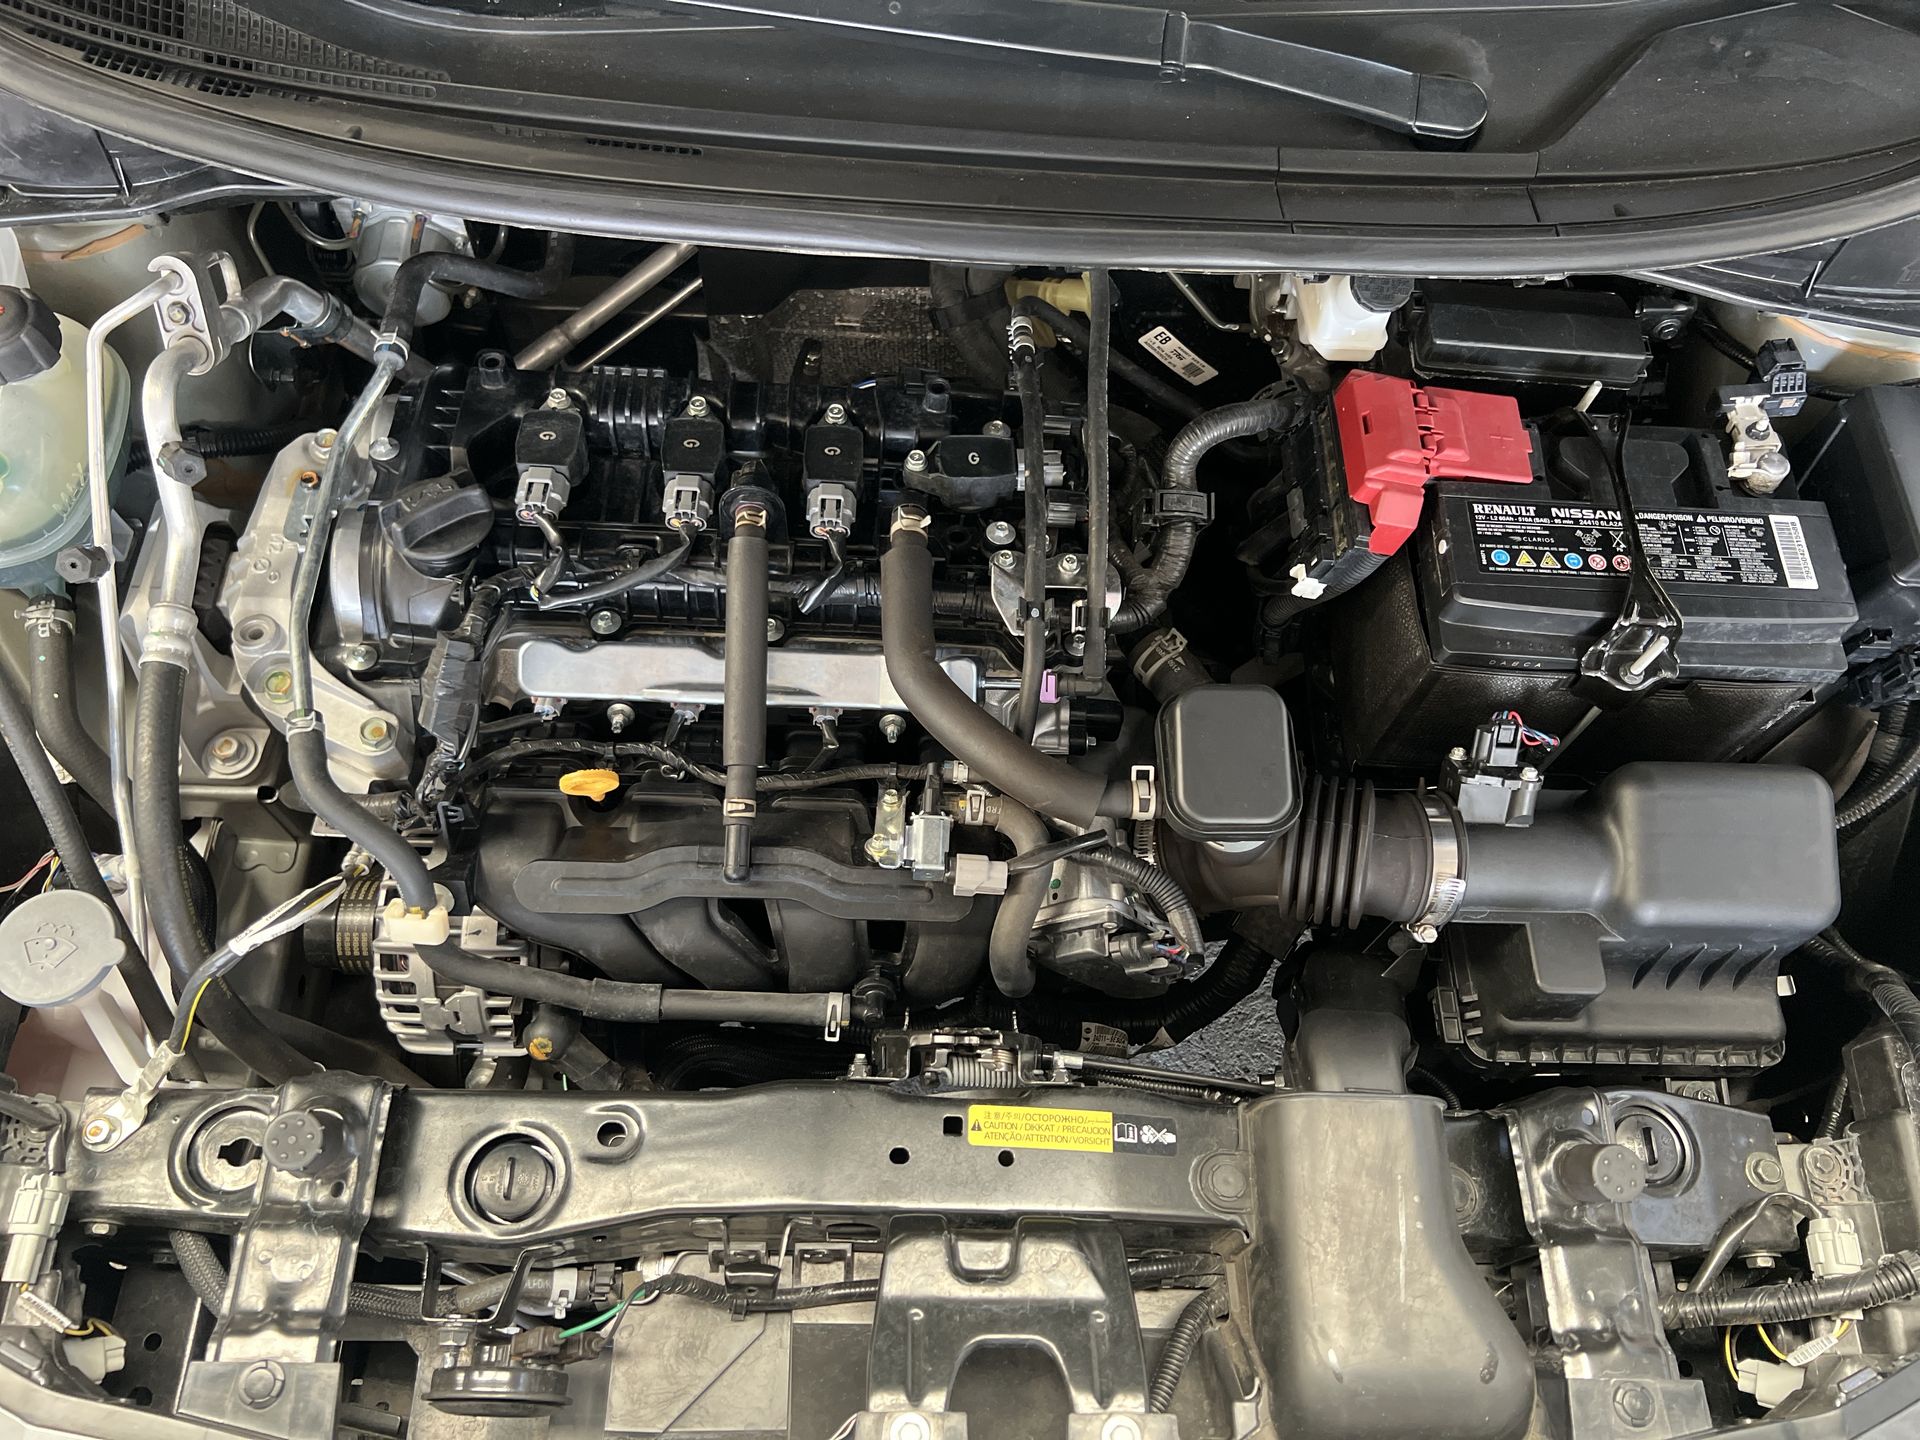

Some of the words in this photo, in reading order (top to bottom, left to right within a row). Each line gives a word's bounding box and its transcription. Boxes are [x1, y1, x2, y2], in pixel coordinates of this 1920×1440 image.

[1154, 331, 1172, 345] EB
[968, 452, 981, 465] G
[1472, 504, 1536, 516] RENAULT
[1551, 507, 1622, 520] NISSAN
[984, 1121, 1018, 1130] CAUTION
[1024, 1123, 1055, 1132] DIKKAT
